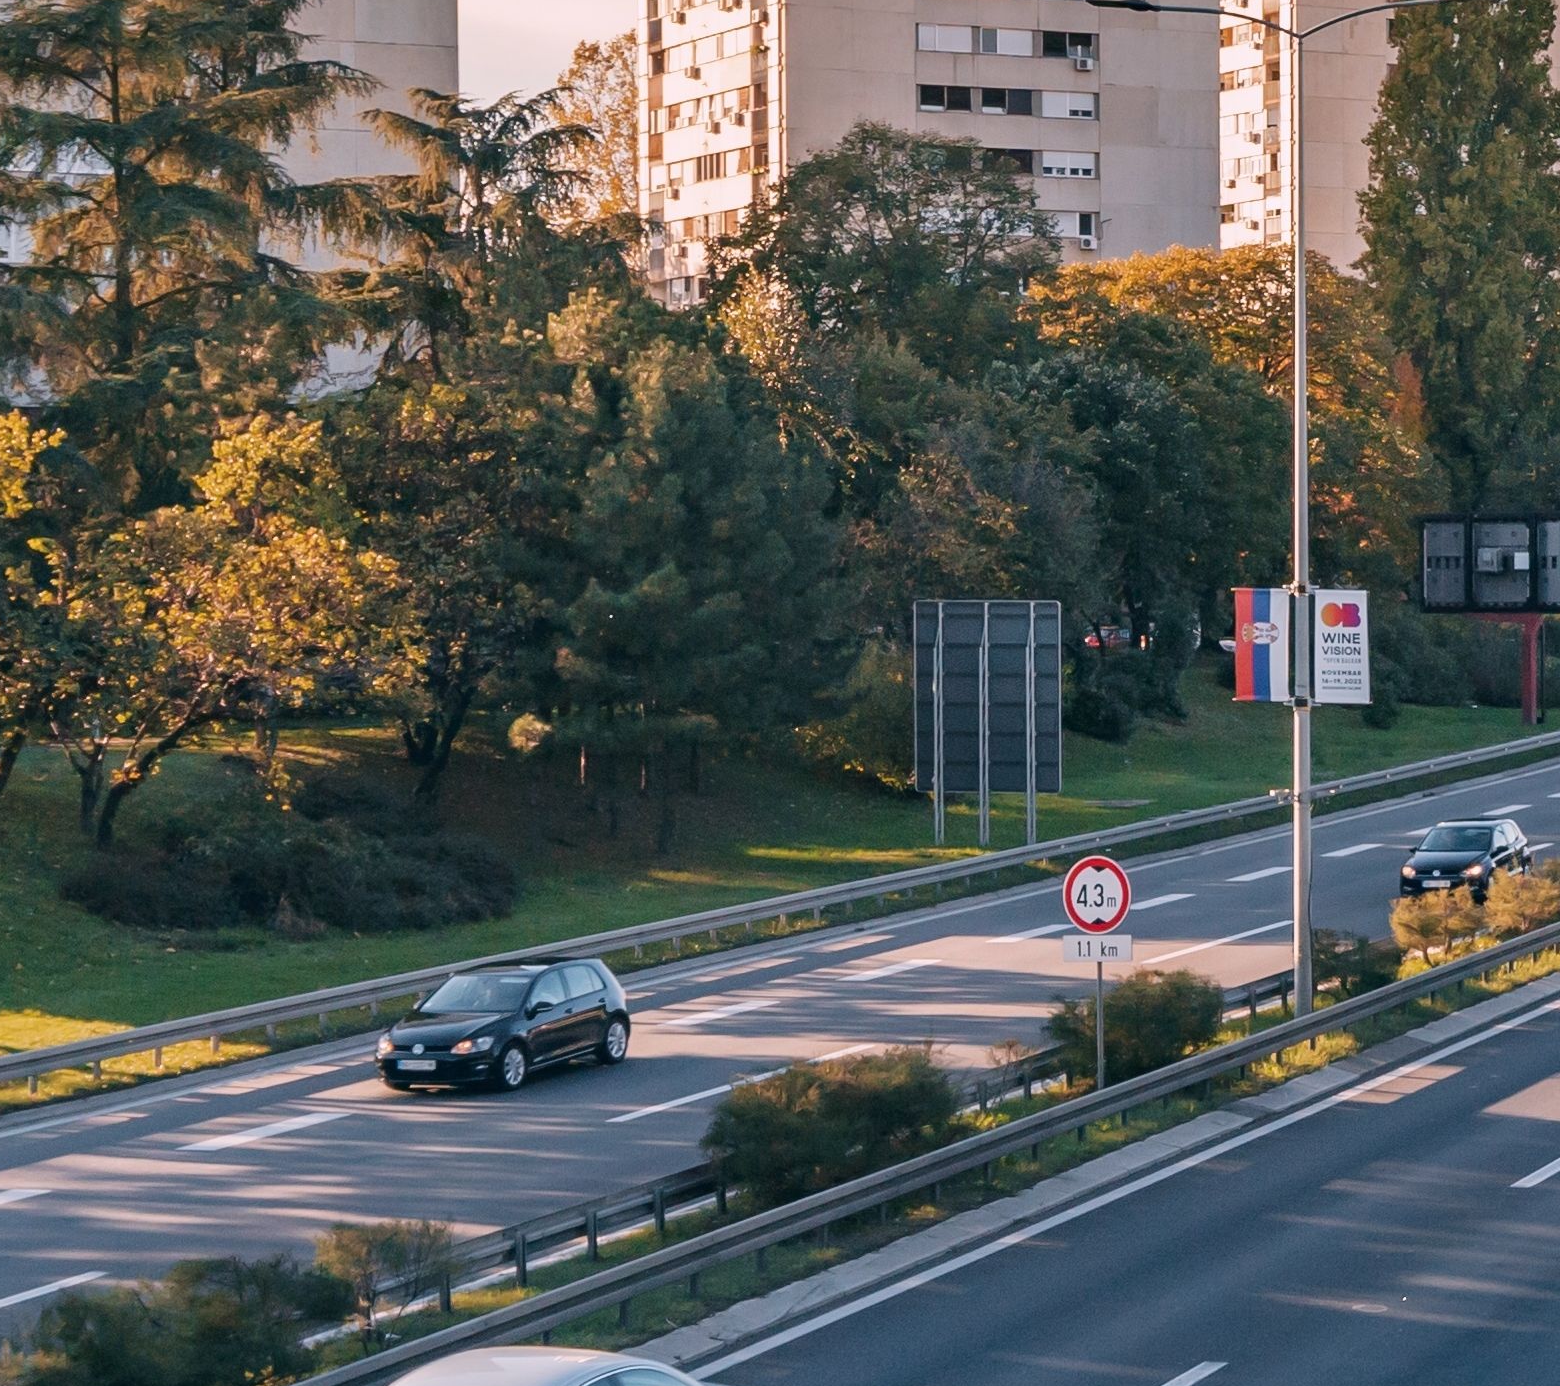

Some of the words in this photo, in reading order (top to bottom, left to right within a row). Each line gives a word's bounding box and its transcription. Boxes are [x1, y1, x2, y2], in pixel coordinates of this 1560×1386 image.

[1321, 632, 1361, 645] WINE
[1321, 646, 1361, 655] VISION
[1076, 883, 1104, 908] 4.3
[1106, 897, 1117, 908] m
[1077, 940, 1091, 958] 1.1
[1100, 941, 1118, 957] km
